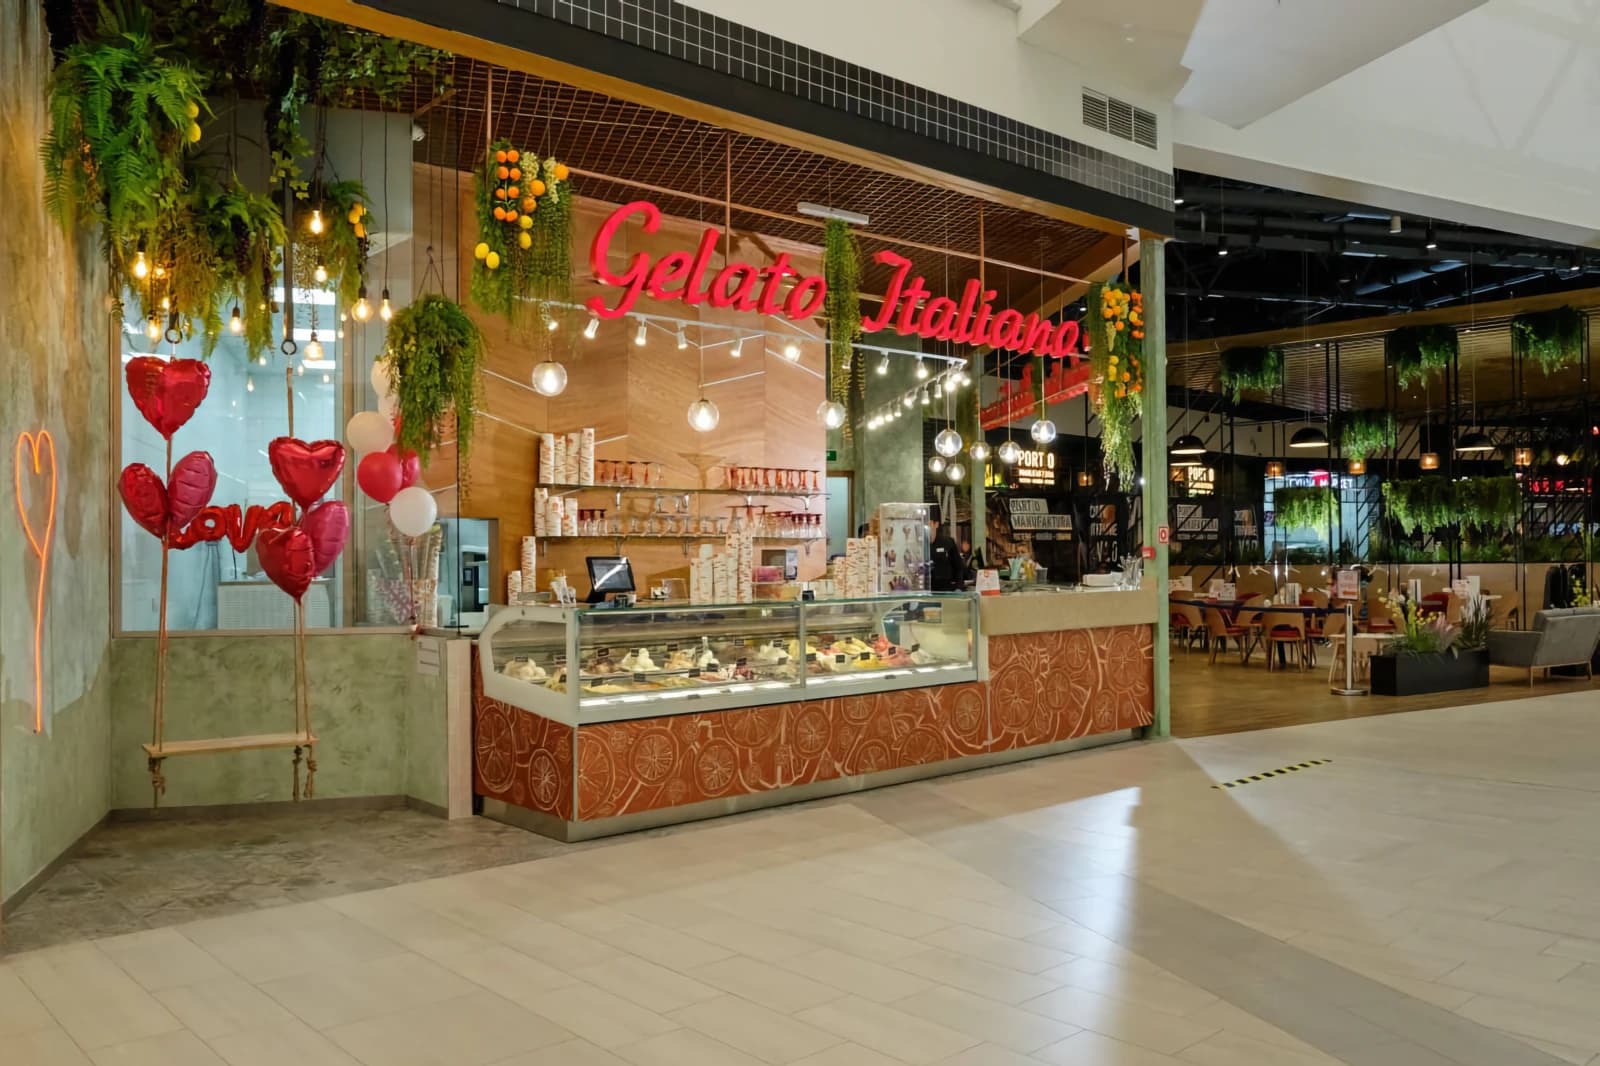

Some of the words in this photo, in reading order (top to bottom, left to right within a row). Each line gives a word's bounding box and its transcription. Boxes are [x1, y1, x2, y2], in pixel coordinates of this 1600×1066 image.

[589, 200, 827, 319] Gelato
[861, 250, 1079, 357] Italiano
[1017, 450, 1045, 467] PORT
[1319, 478, 1353, 489] MRKET
